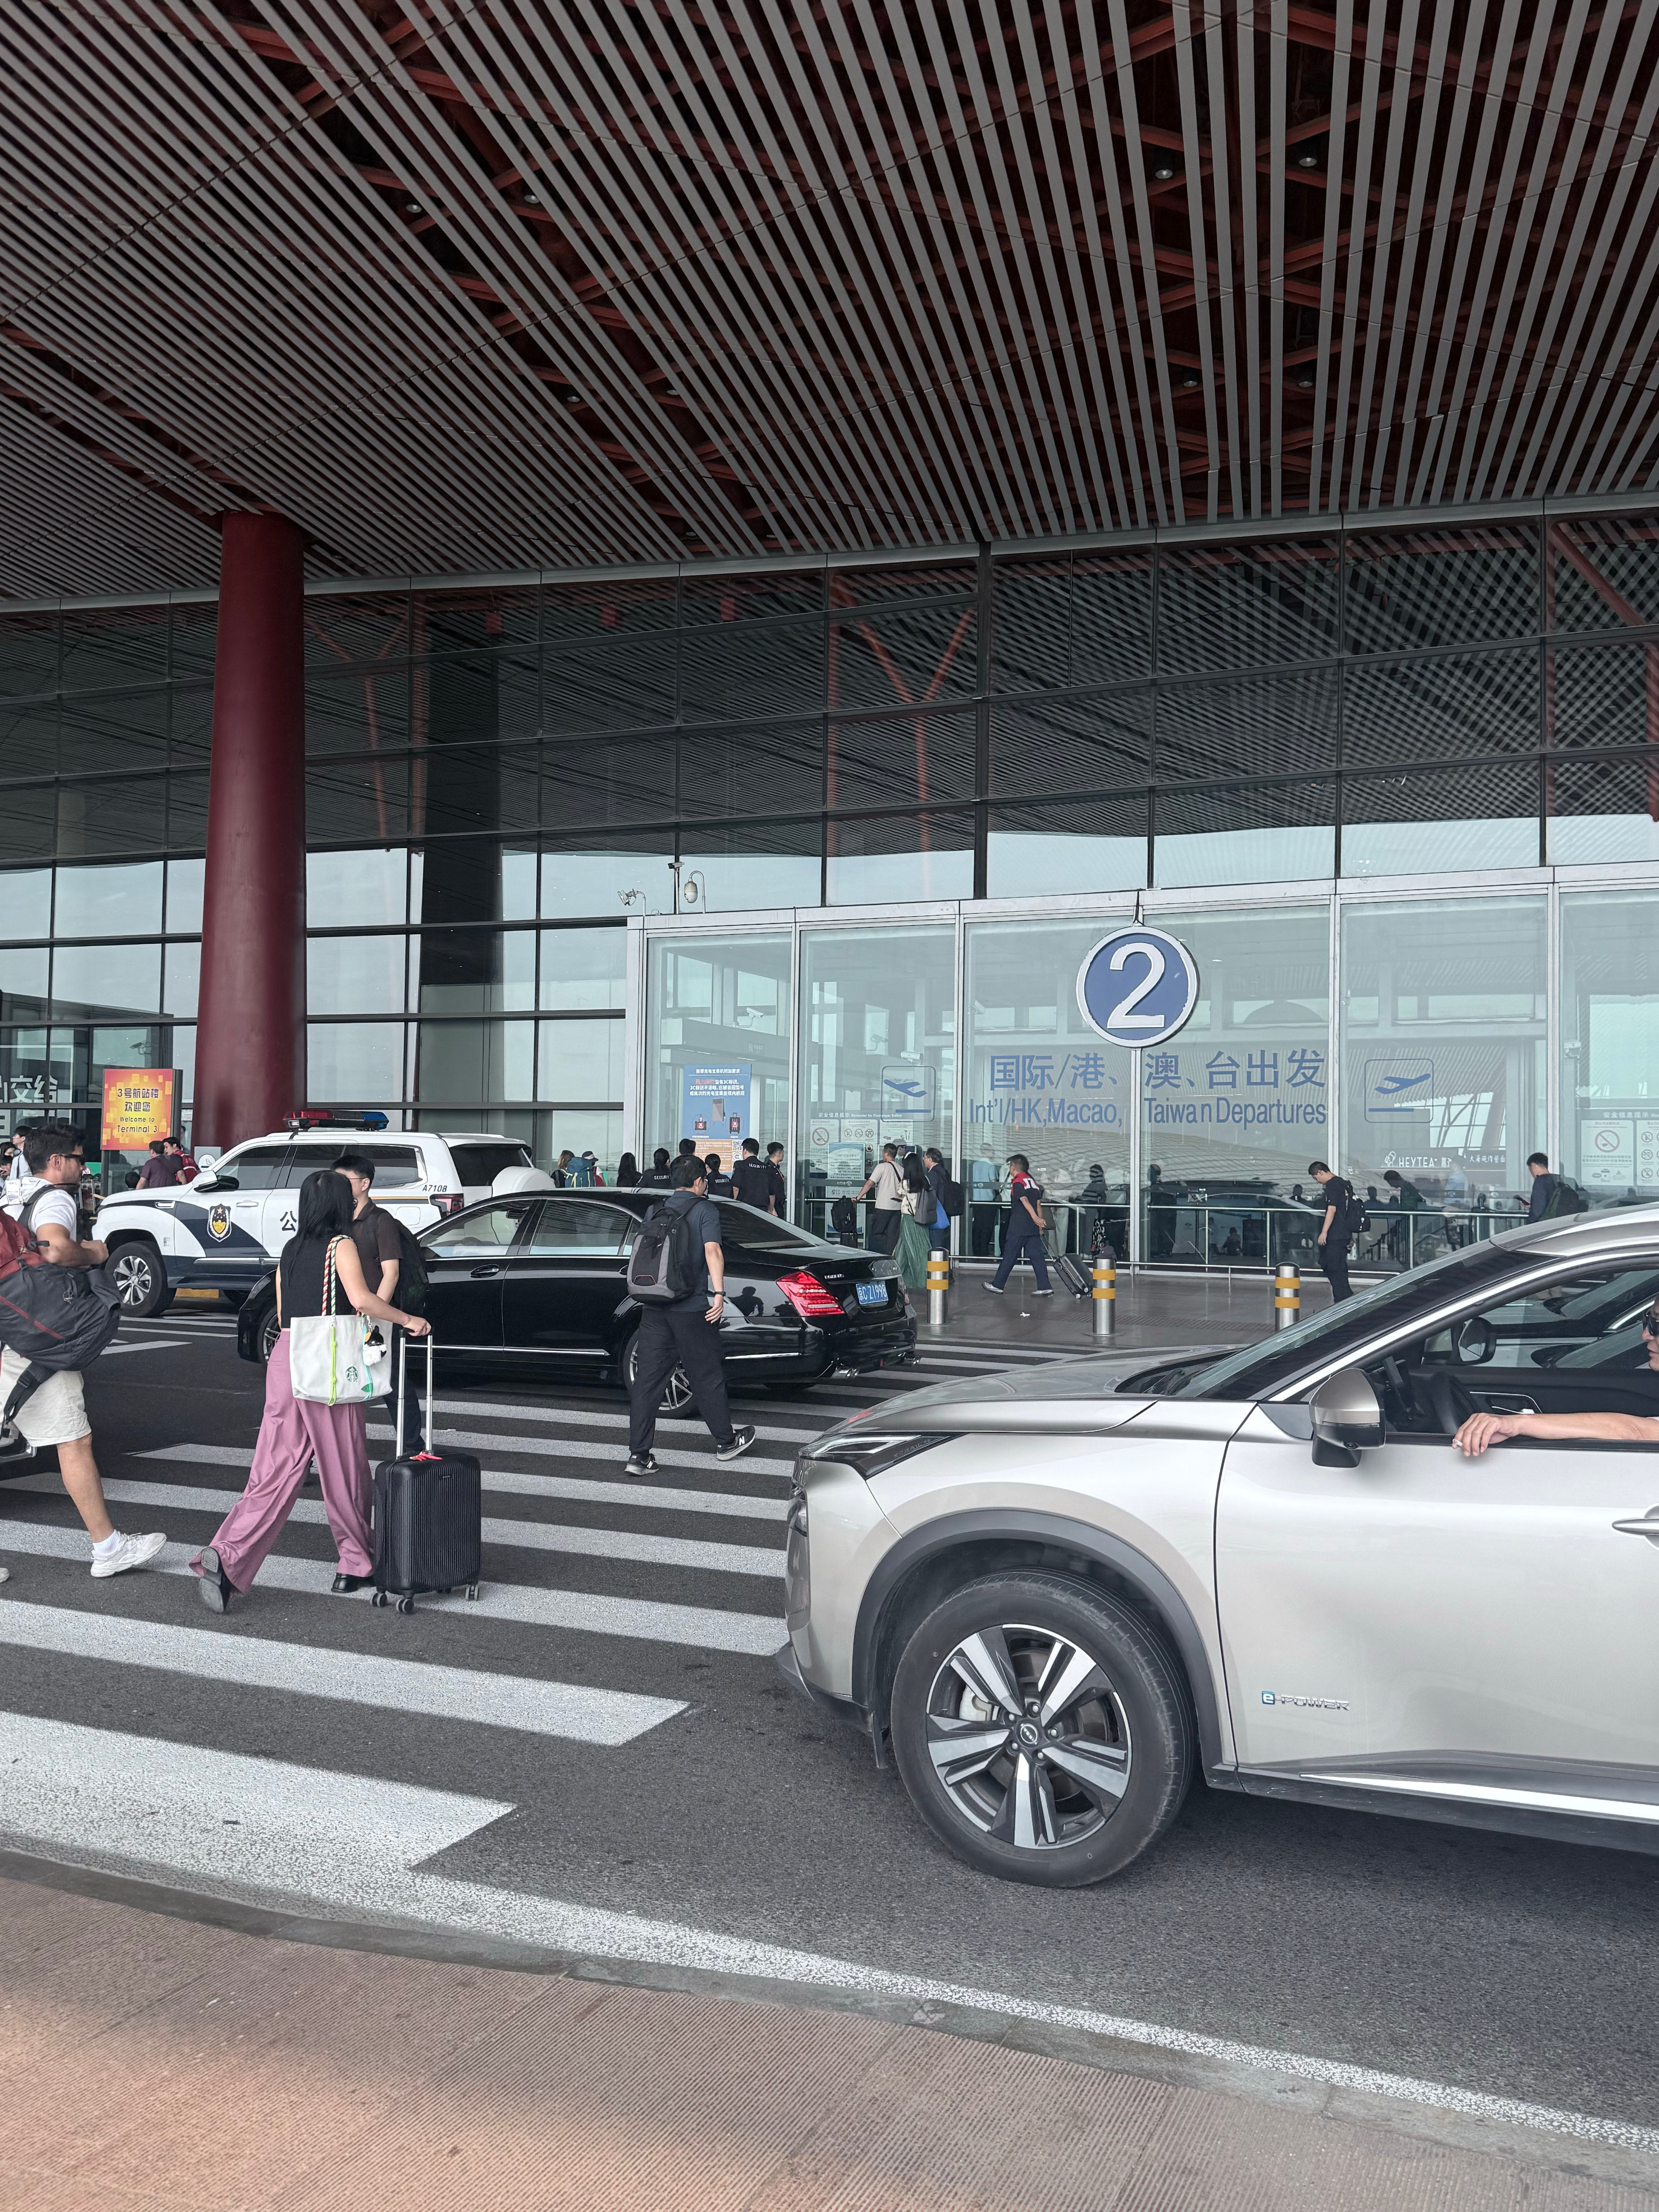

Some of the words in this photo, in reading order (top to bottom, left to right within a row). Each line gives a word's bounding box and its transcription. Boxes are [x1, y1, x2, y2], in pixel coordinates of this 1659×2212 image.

[1107, 942, 1165, 1029] 2
[1145, 1048, 1325, 1089] 澳、台出发
[117, 1088, 159, 1098] 3号航站楼
[125, 1102, 150, 1112] 欢迎您
[1144, 1097, 1212, 1123] Taiwan
[1216, 1097, 1326, 1130] Departures
[1399, 1157, 1434, 1167] HEYTEA
[280, 1211, 297, 1232] 公
